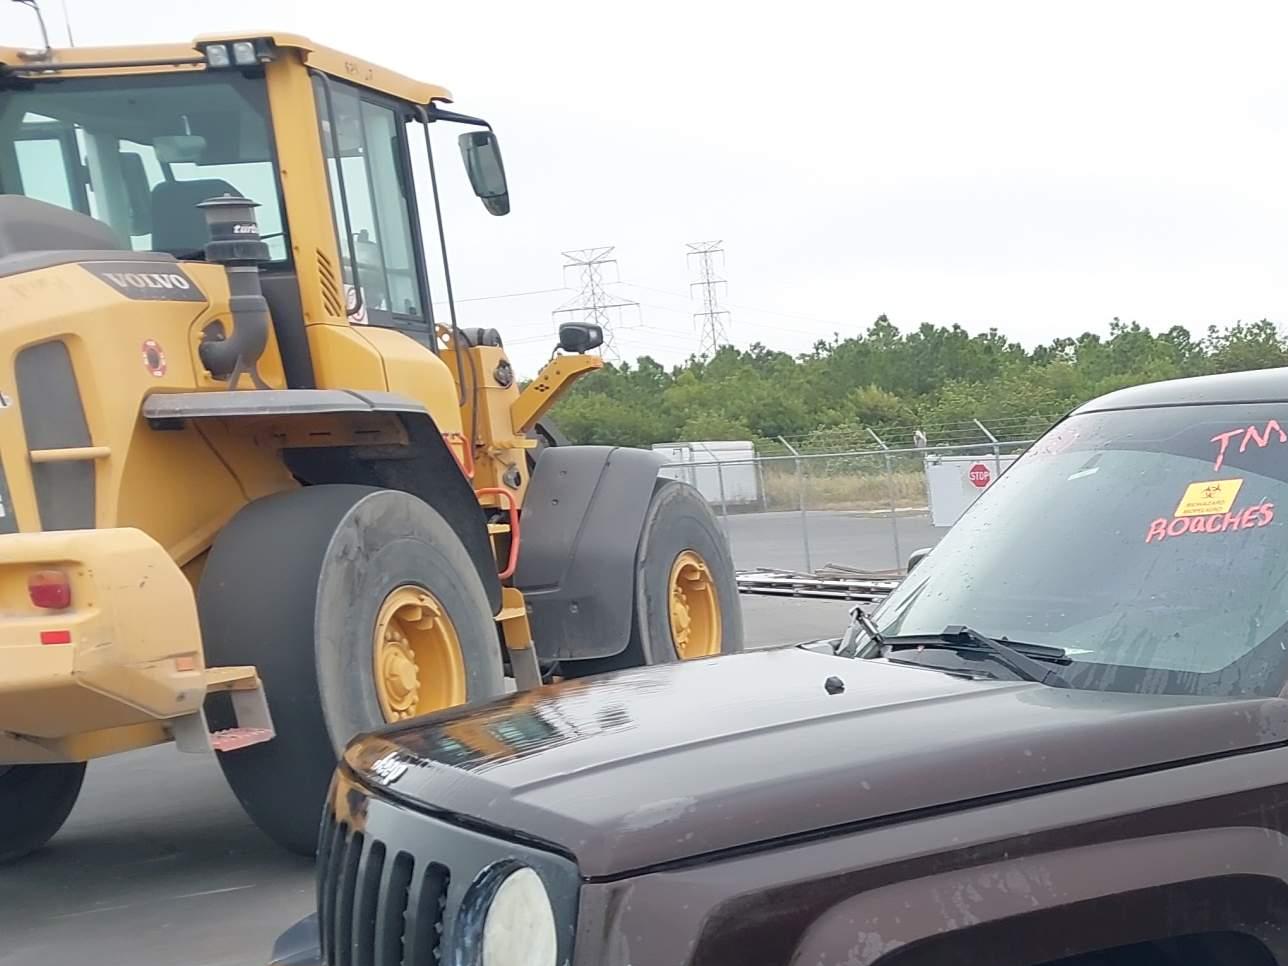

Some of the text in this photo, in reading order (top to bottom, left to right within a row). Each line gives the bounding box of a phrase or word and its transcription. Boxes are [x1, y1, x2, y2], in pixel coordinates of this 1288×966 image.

[102, 272, 190, 289] VOLVO
[1210, 419, 1288, 472] TM
[969, 471, 990, 481] STOP
[1145, 501, 1275, 543] ROACHES
